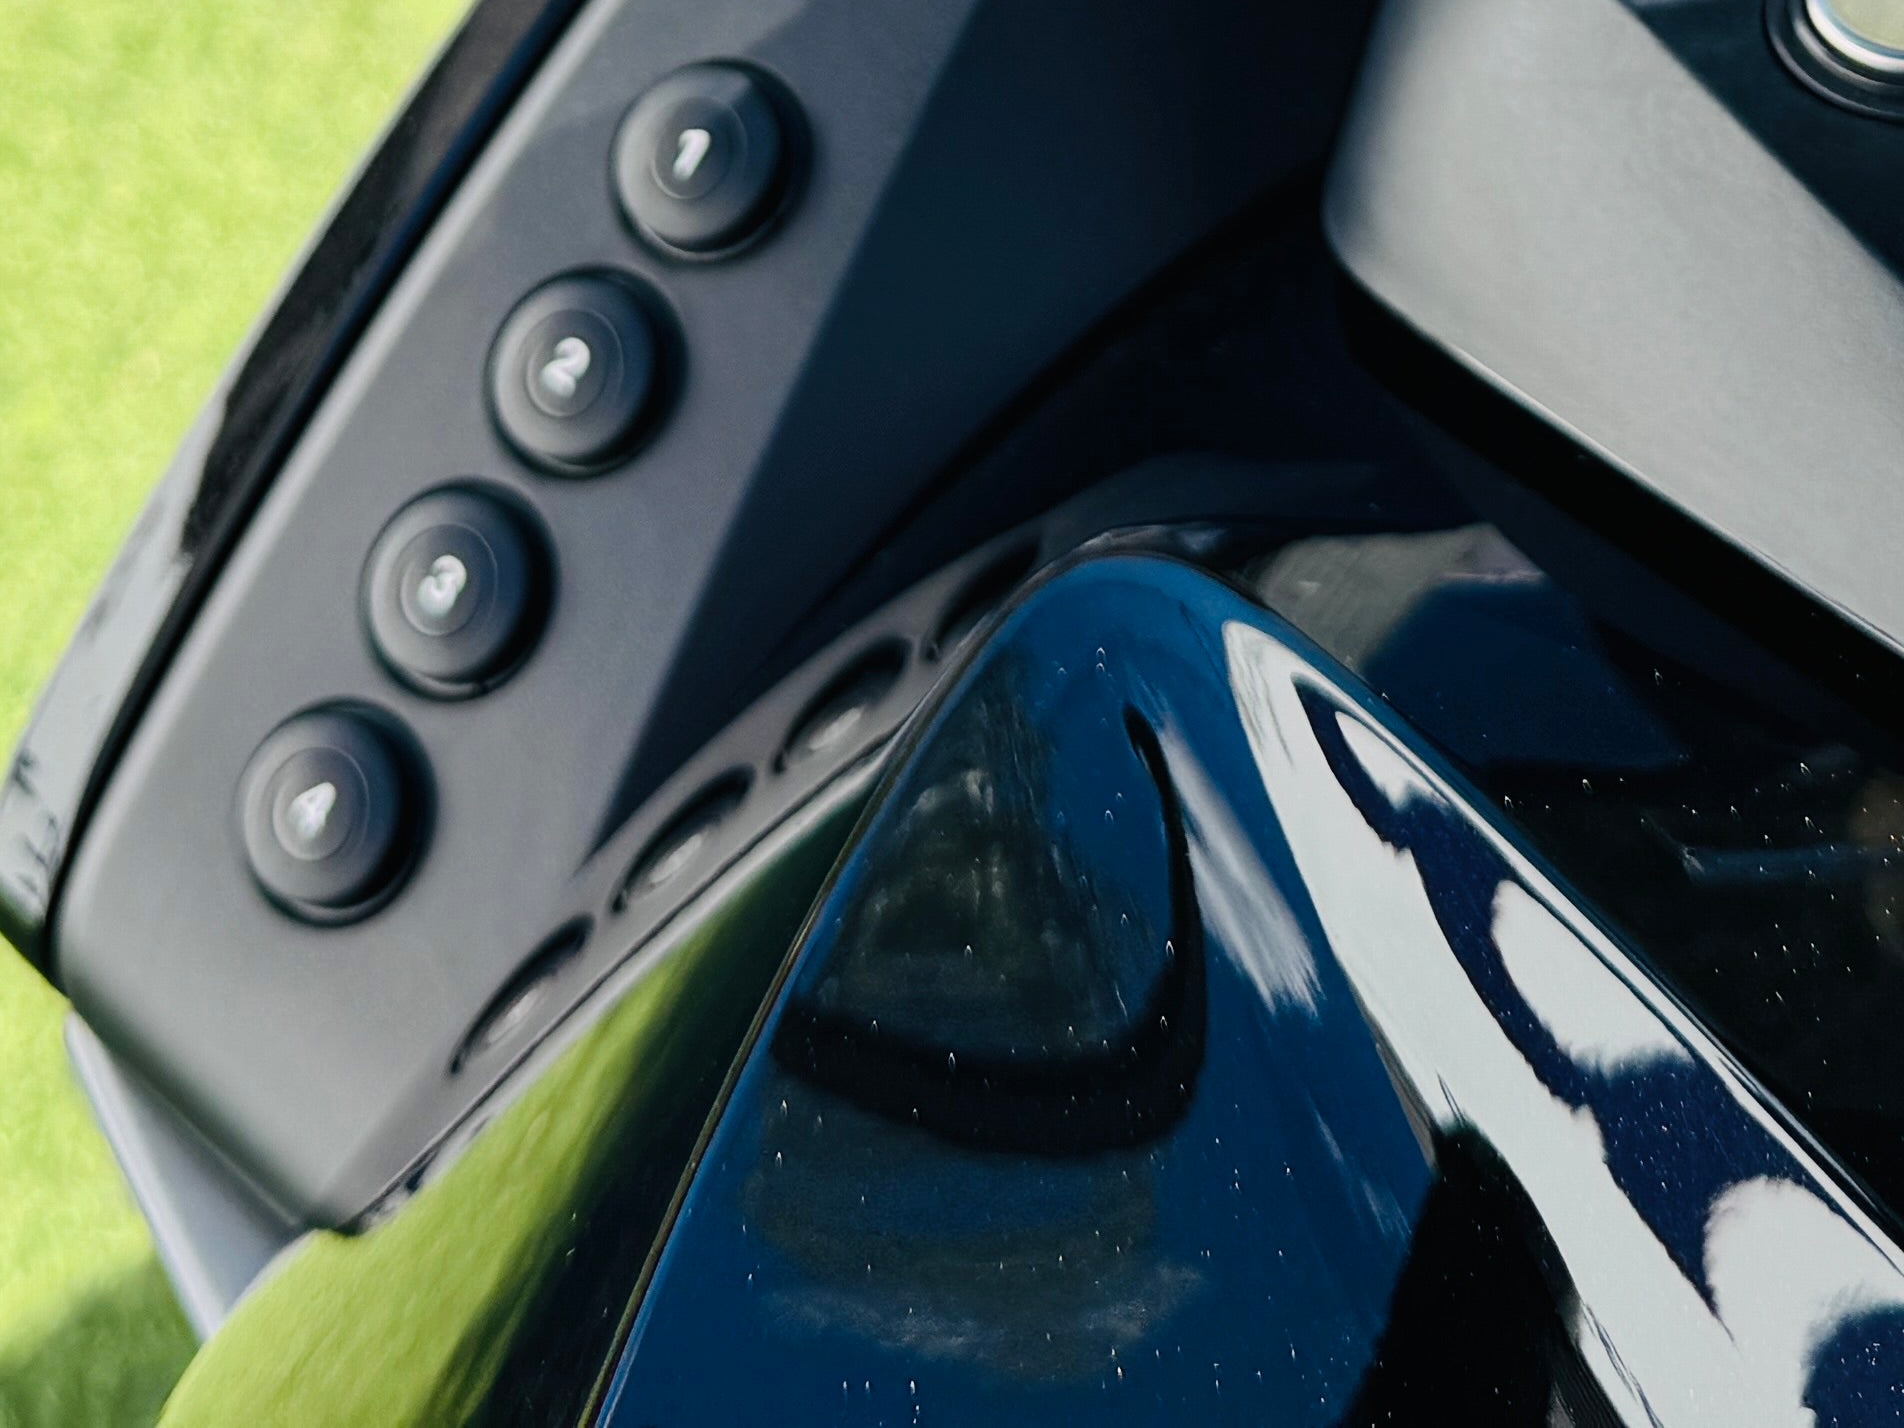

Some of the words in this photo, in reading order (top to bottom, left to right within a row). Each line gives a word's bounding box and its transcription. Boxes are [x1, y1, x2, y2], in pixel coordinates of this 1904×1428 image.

[672, 129, 711, 181] 1
[541, 337, 590, 397] 2
[417, 555, 466, 617] 3
[290, 782, 336, 840] 4
